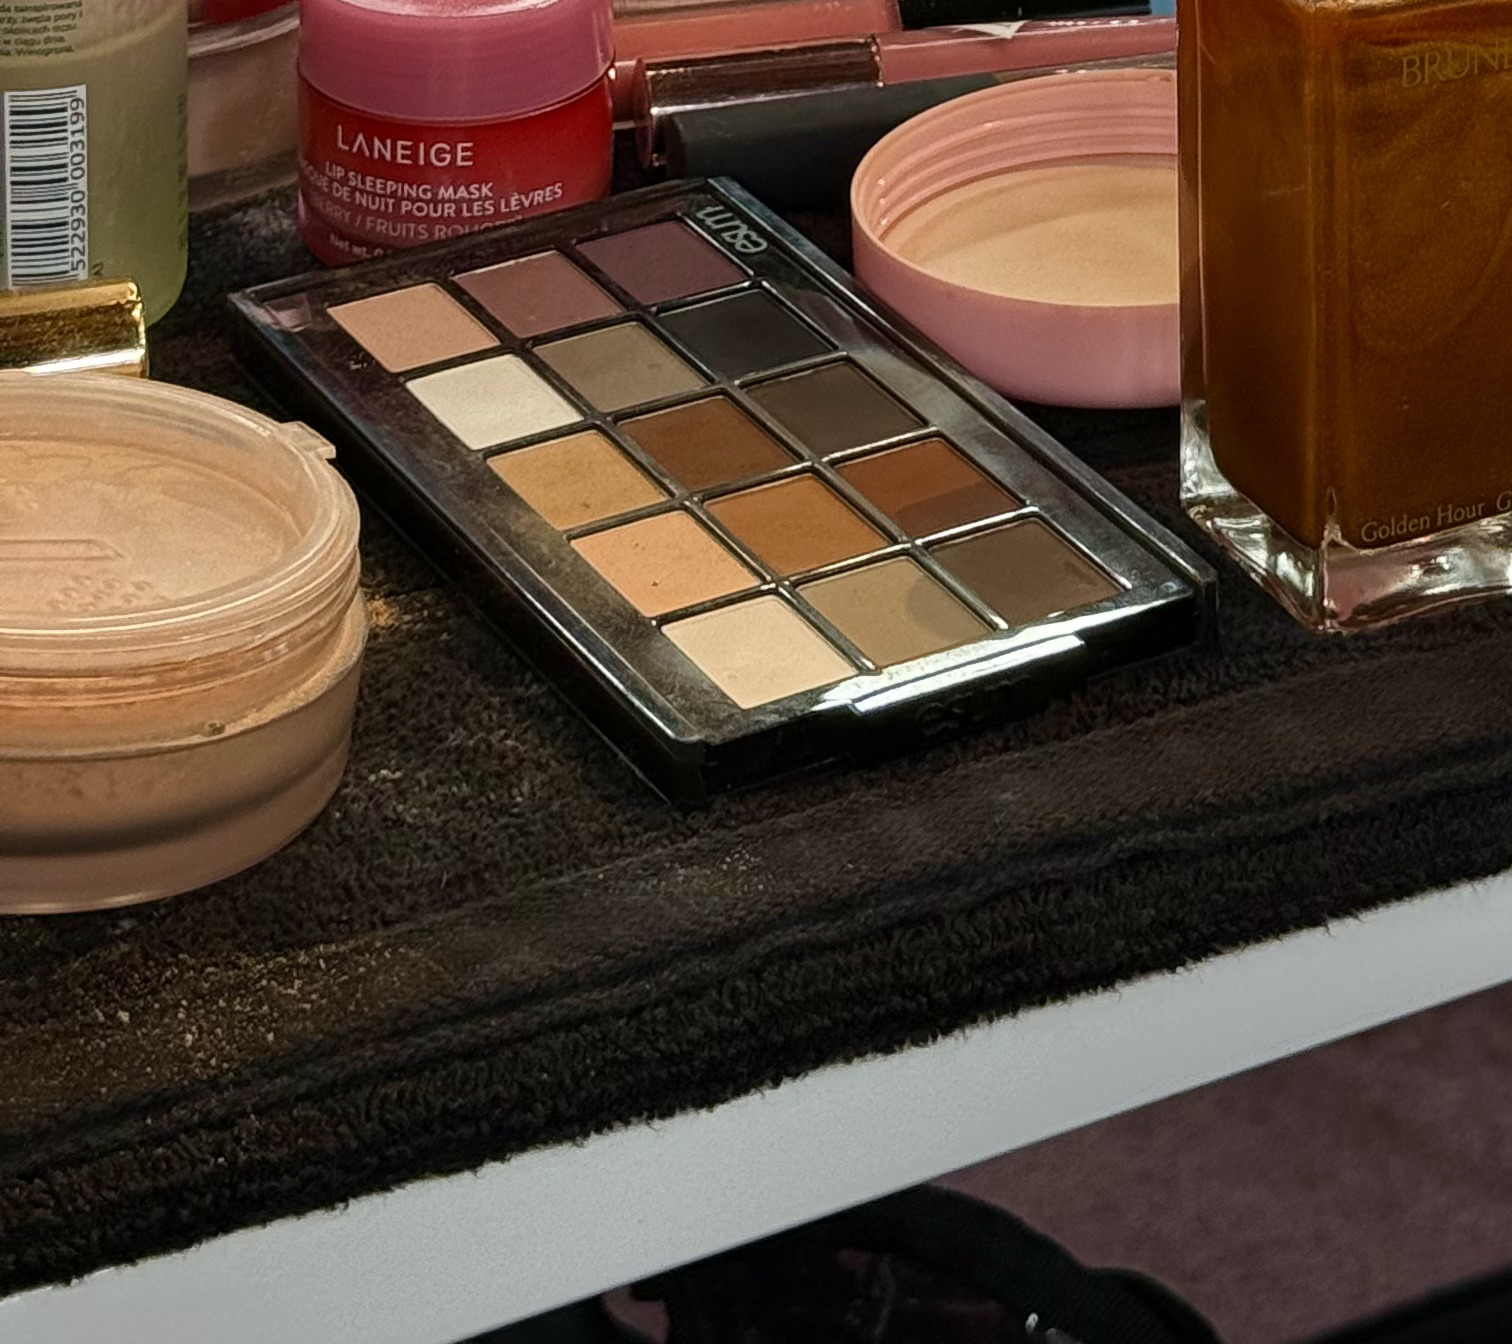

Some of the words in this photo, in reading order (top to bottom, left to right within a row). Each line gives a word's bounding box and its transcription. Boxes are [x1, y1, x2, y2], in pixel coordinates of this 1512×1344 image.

[69, 96, 86, 182] 003199
[336, 123, 475, 167] LANEIGE
[324, 160, 346, 180] LIP
[347, 170, 433, 201] SLEEPING
[437, 181, 494, 200] MASK
[332, 182, 351, 202] DE
[355, 189, 394, 213] NUIT
[399, 199, 457, 218] POUR
[461, 199, 496, 217] LES
[498, 181, 565, 213] LÈVRES
[69, 189, 87, 273] 522930
[364, 216, 430, 240] FRUITS
[1360, 513, 1431, 543] Golden
[1436, 500, 1486, 526] Hour
